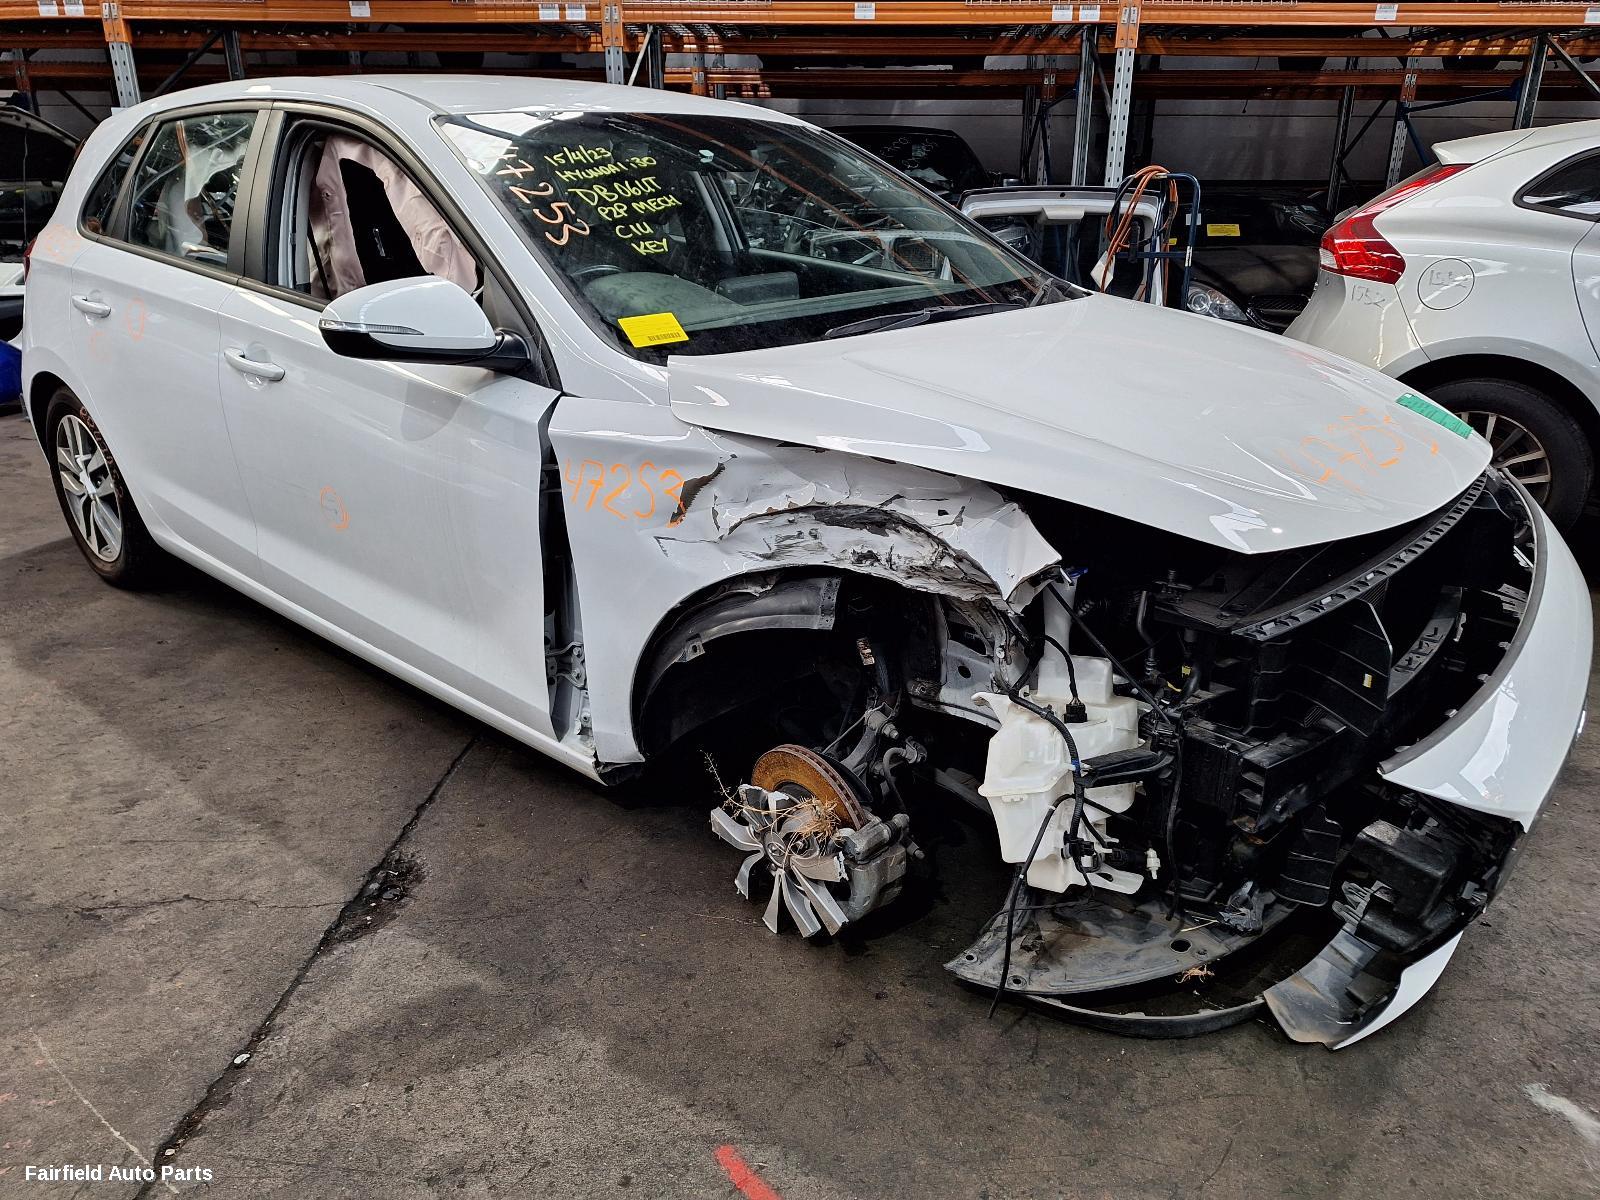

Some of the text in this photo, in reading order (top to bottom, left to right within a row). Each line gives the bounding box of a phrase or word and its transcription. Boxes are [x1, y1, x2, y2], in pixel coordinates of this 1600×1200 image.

[544, 145, 611, 167] 15/4/23
[555, 162, 628, 182] HYUNDAI
[631, 194, 682, 214] MECH
[631, 238, 668, 256] KEY
